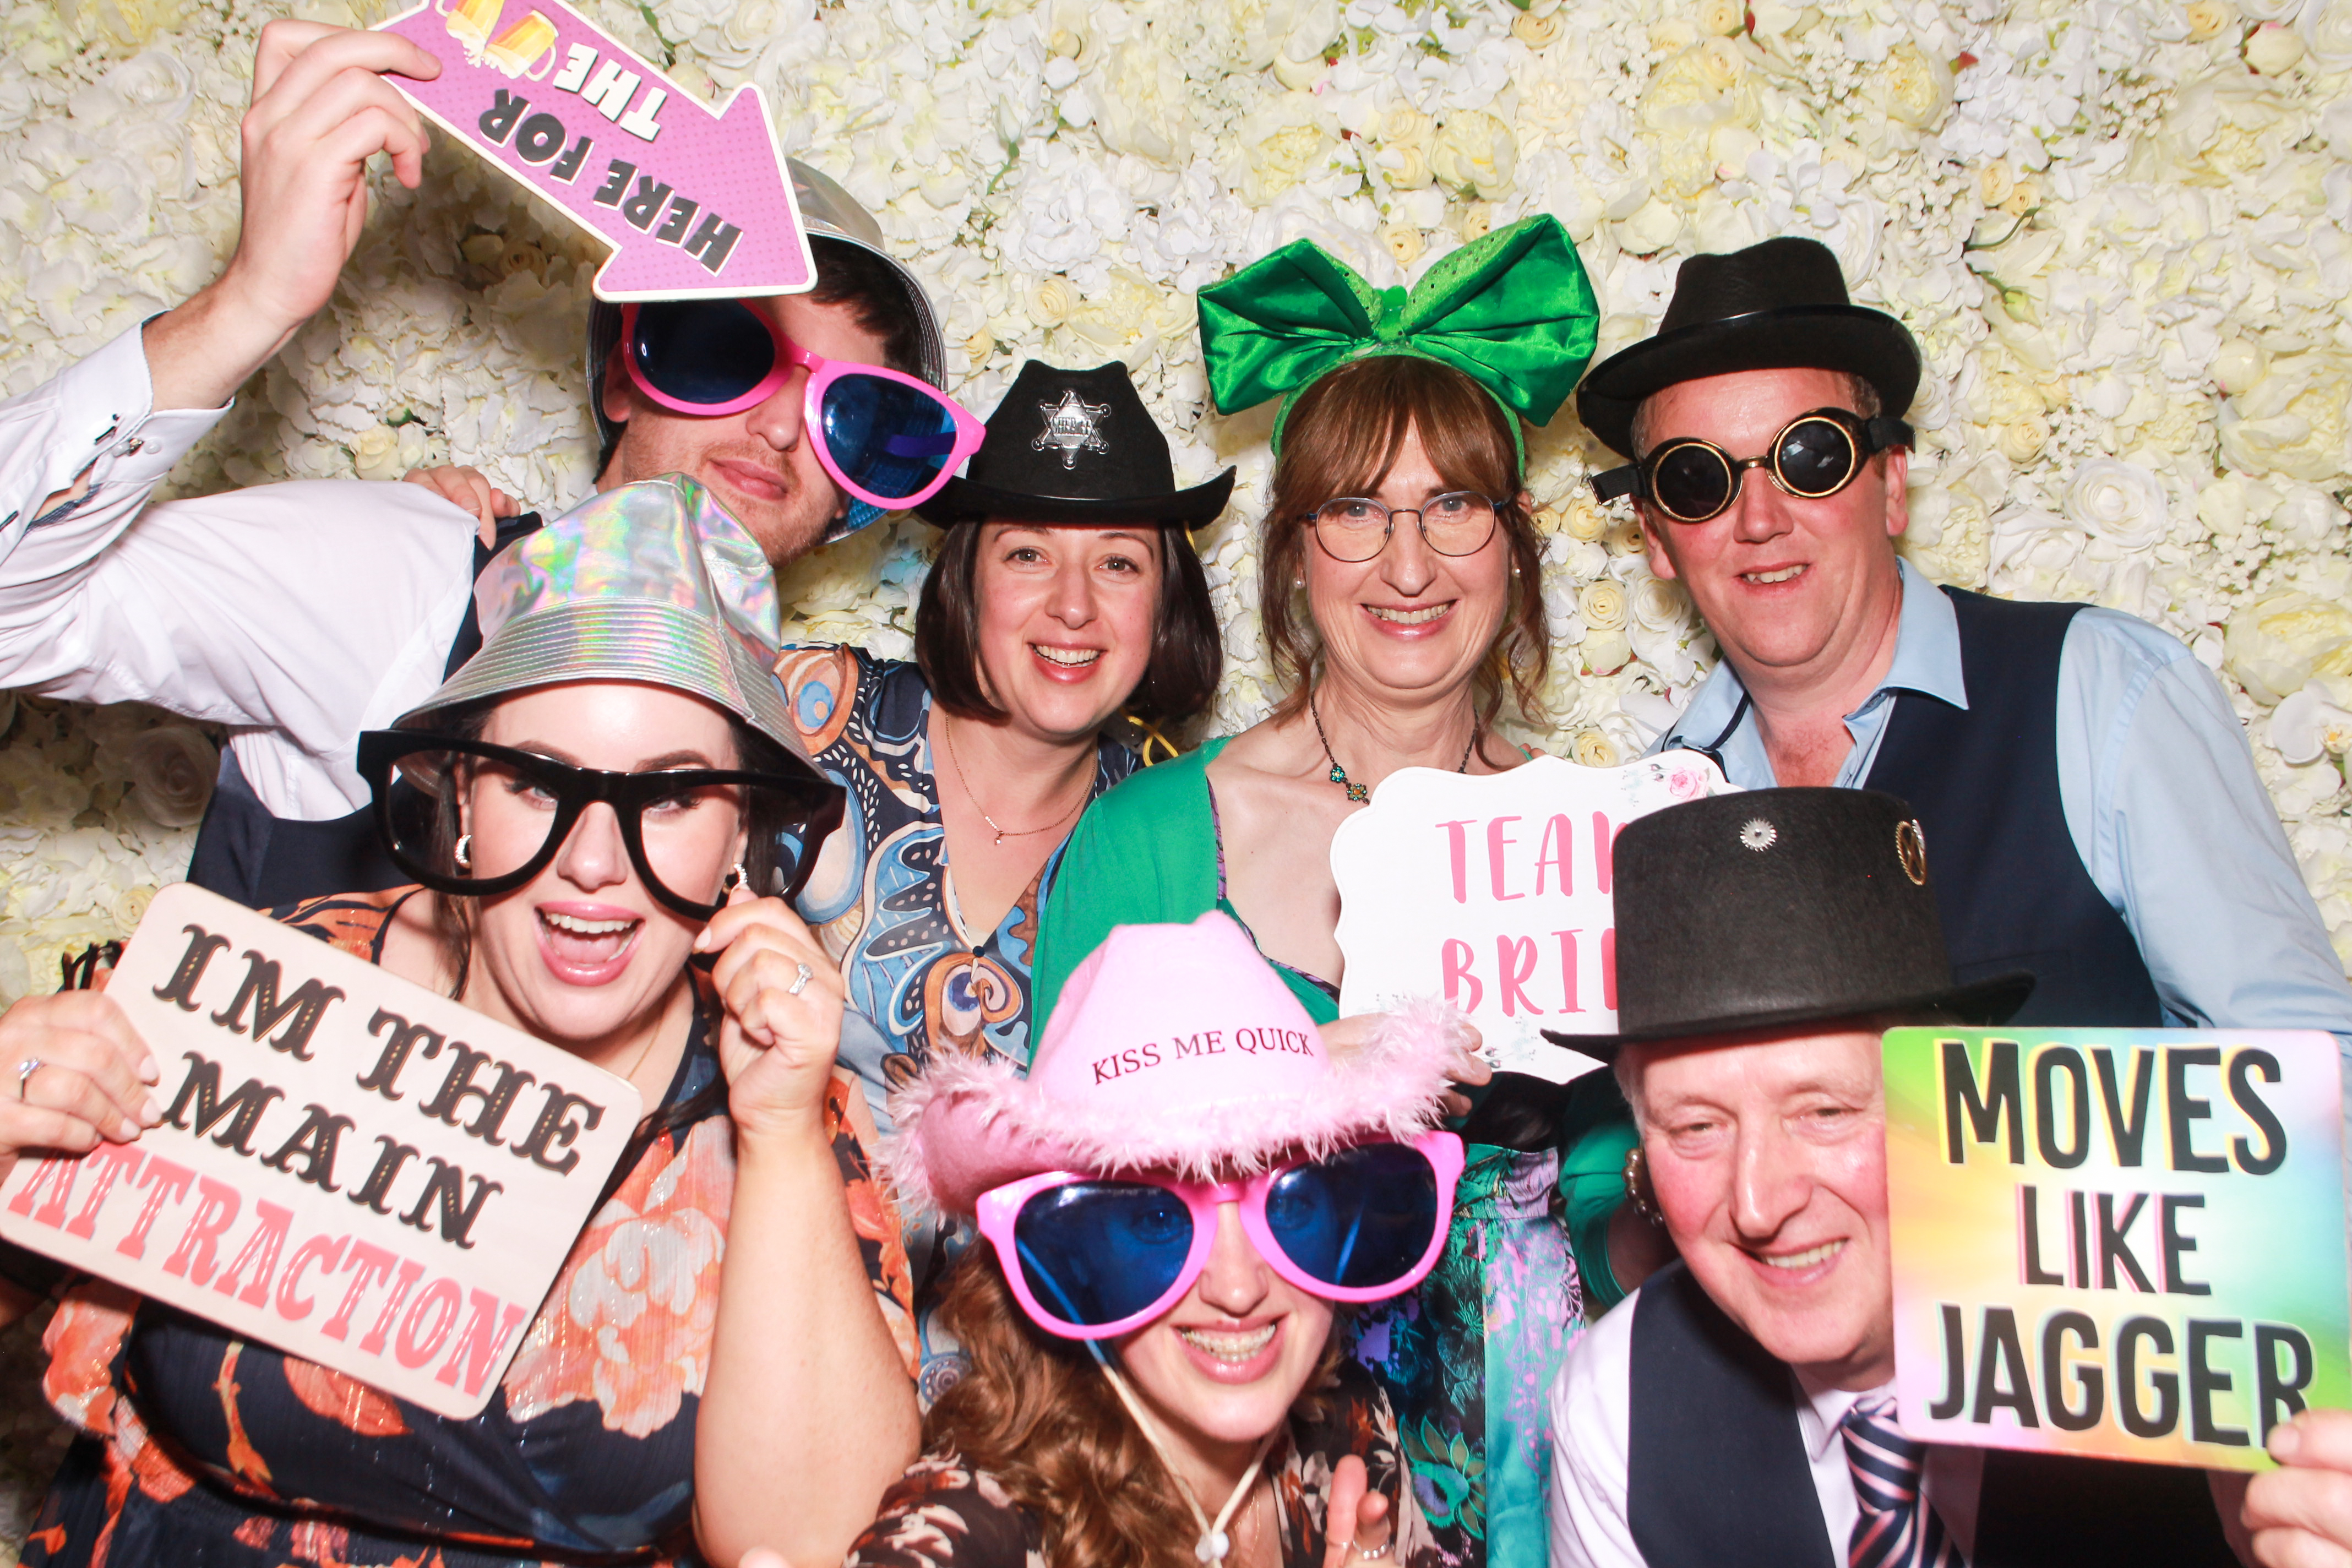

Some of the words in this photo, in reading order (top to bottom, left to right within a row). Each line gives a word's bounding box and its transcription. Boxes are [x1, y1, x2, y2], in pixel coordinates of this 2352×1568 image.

[478, 89, 595, 186] FOR
[552, 42, 668, 142] THE
[594, 159, 744, 277] HERE
[153, 923, 345, 1061] IM
[356, 1005, 606, 1177] THE
[1092, 1043, 1161, 1085] KISS
[1172, 1030, 1226, 1059] ME
[1235, 1027, 1314, 1057] QUICK
[1936, 1039, 2288, 1175] MOVES
[161, 1050, 503, 1250] MAIN
[7, 1141, 527, 1399] ATTRACTION
[2017, 1184, 2212, 1295] LIKE
[1925, 1301, 2313, 1449] JAGGER
